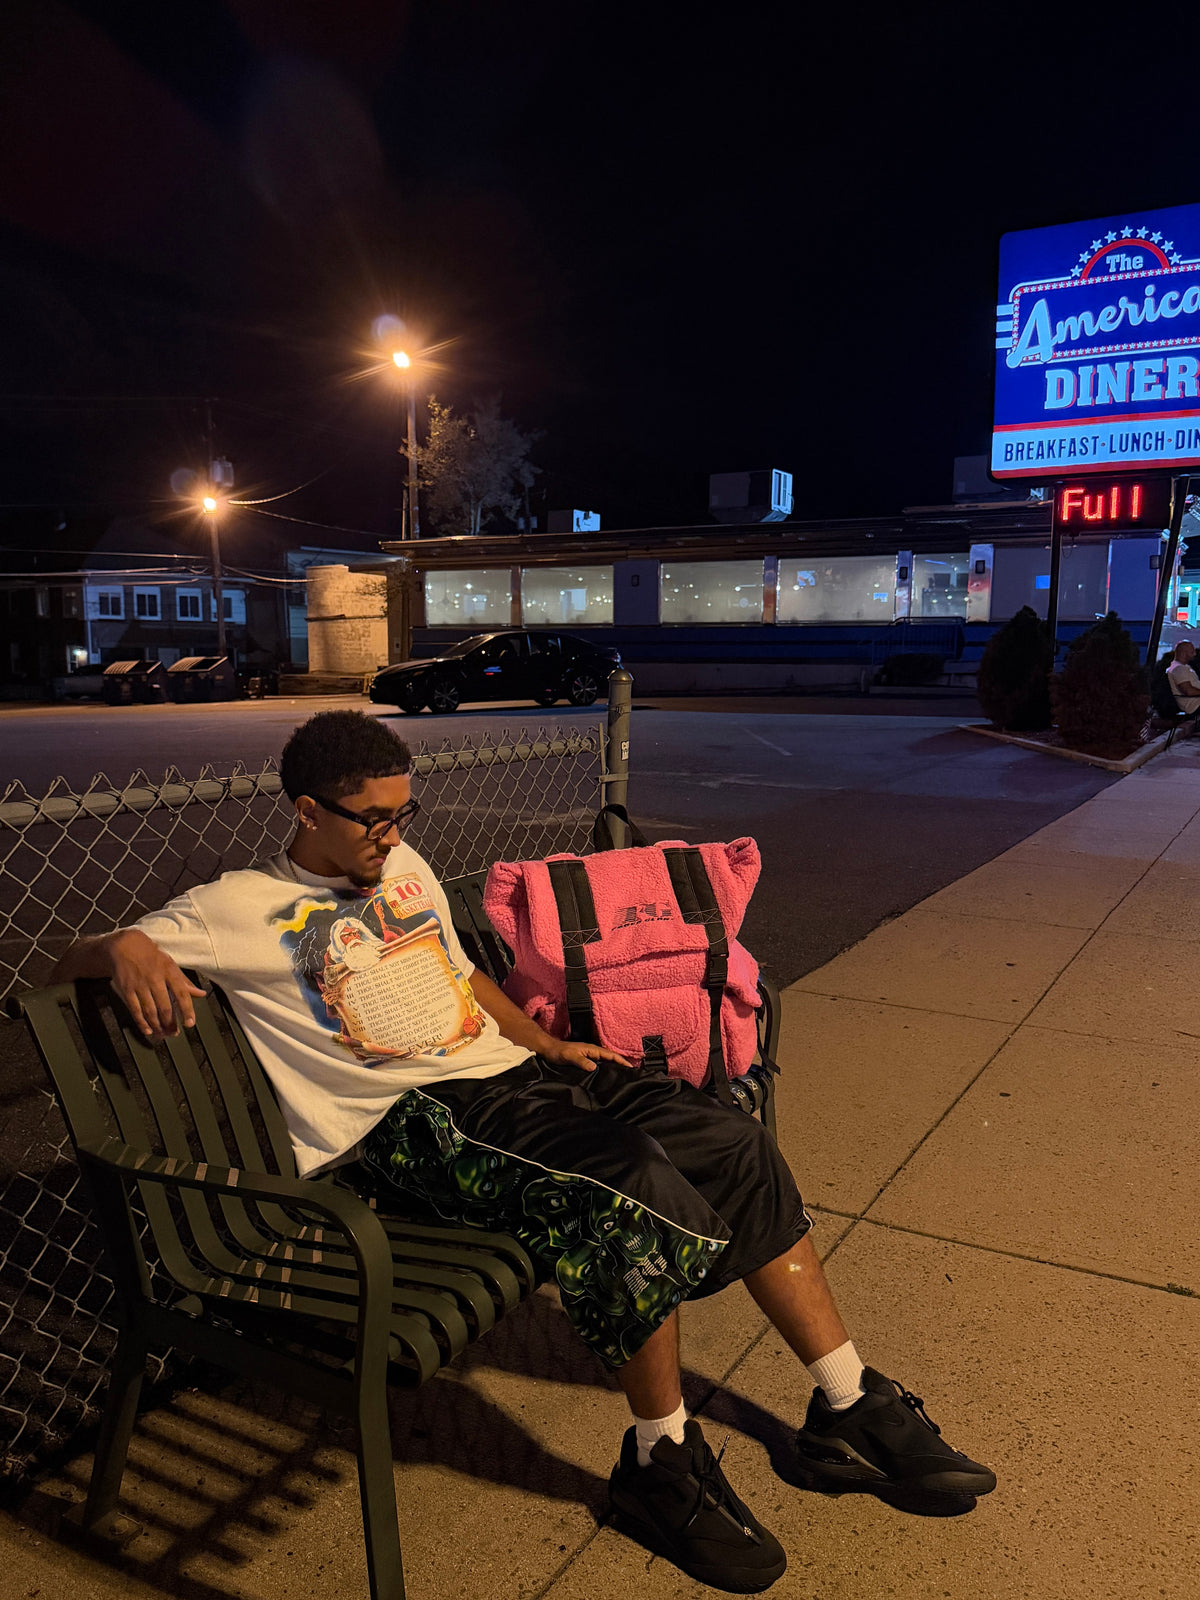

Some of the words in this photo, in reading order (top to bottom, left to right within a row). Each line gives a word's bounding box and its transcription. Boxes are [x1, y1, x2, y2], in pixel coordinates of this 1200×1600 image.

[1106, 253, 1144, 273] The
[1044, 356, 1200, 410] DINER
[1004, 435, 1100, 462] BREAKFAST
[1109, 430, 1165, 454] LUNCH
[1061, 484, 1141, 521] Full
[391, 881, 423, 901] 10
[409, 1033, 444, 1052] EVER!
